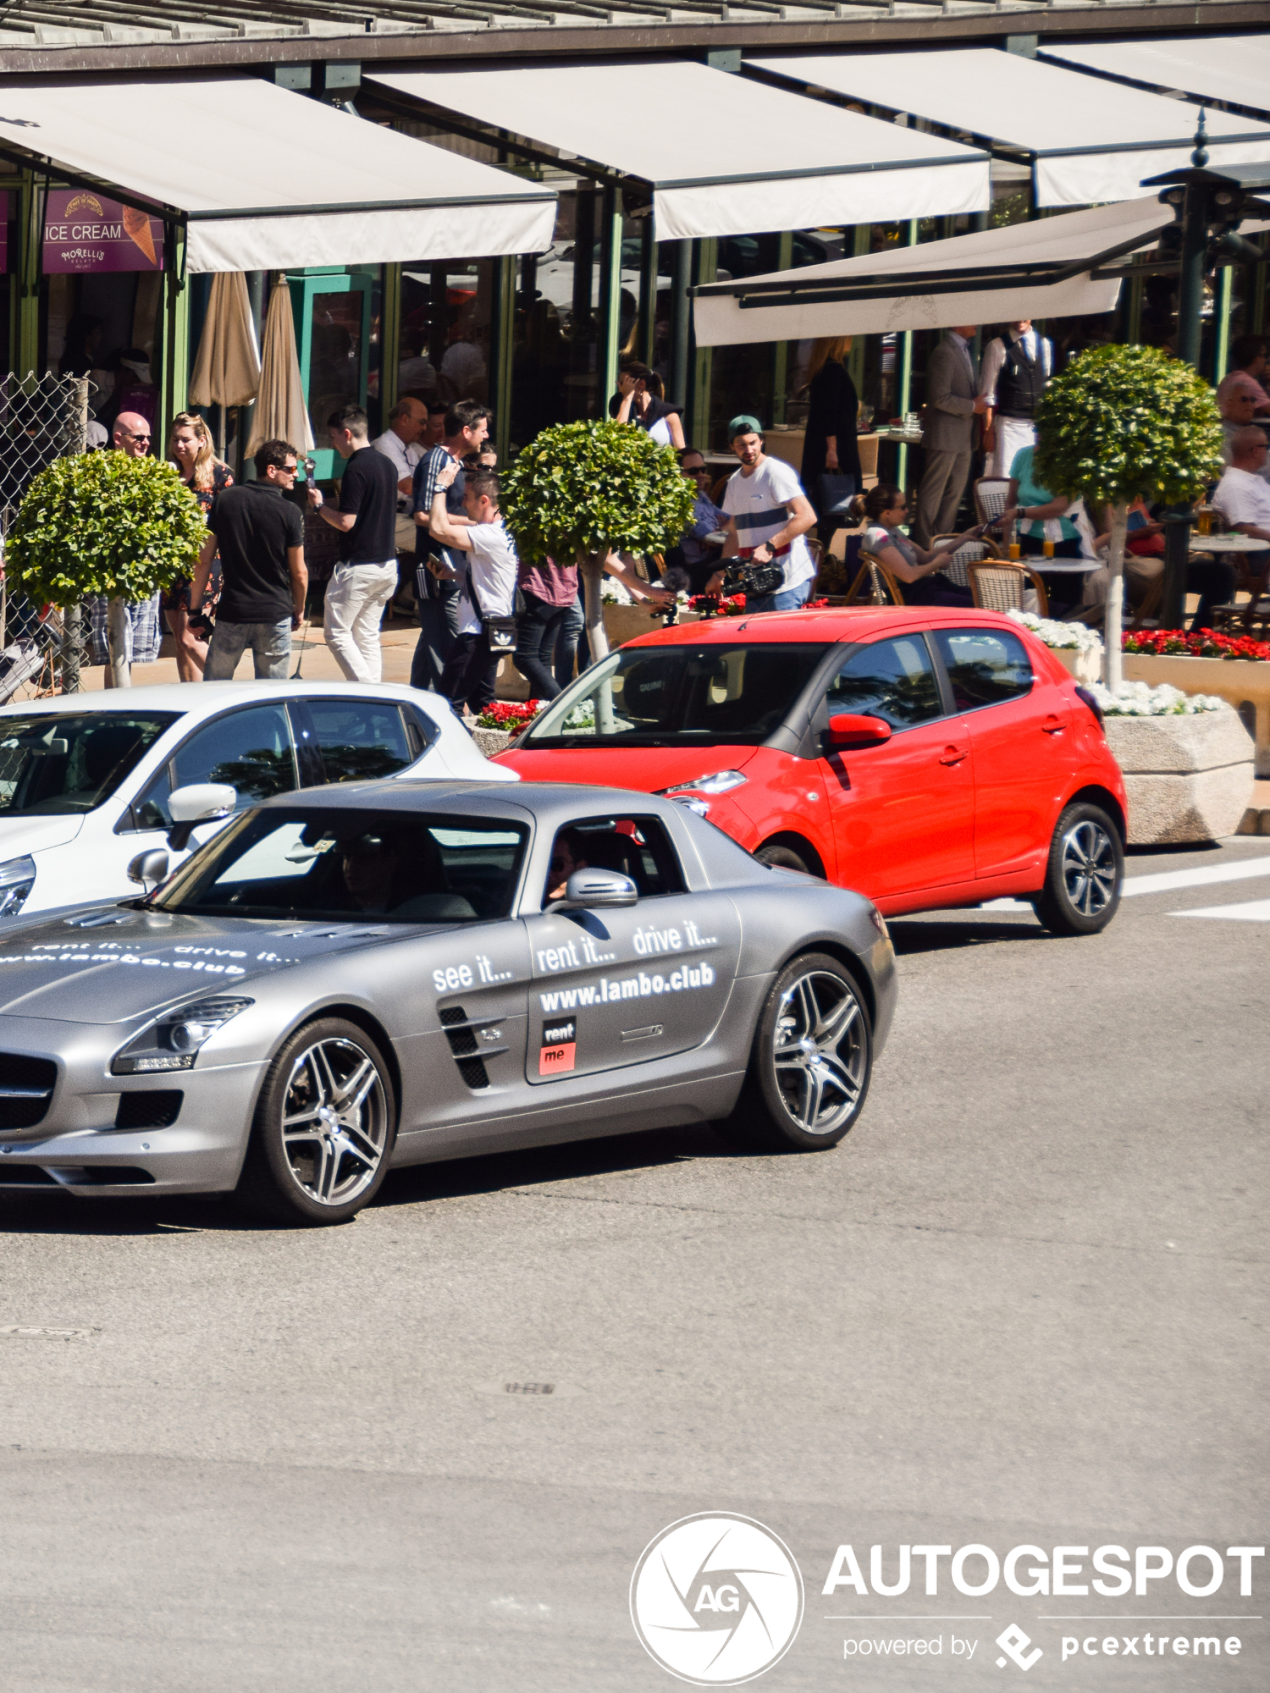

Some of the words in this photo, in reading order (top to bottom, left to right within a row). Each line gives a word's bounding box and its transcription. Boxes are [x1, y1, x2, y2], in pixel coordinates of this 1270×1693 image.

[45, 226, 68, 240] ICE
[71, 225, 121, 240] CREAM
[61, 248, 105, 261] MORELLI'S
[32, 943, 90, 951] rent
[174, 946, 247, 958] drive
[256, 951, 301, 963] it...
[536, 939, 580, 972] rent
[580, 936, 615, 963] it...
[632, 925, 682, 955] drive
[682, 920, 717, 946] it...
[432, 964, 473, 992] see
[475, 955, 512, 983] it...
[540, 962, 714, 1012] www.lambo.club
[544, 1022, 574, 1042] rent
[544, 1049, 565, 1062] me
